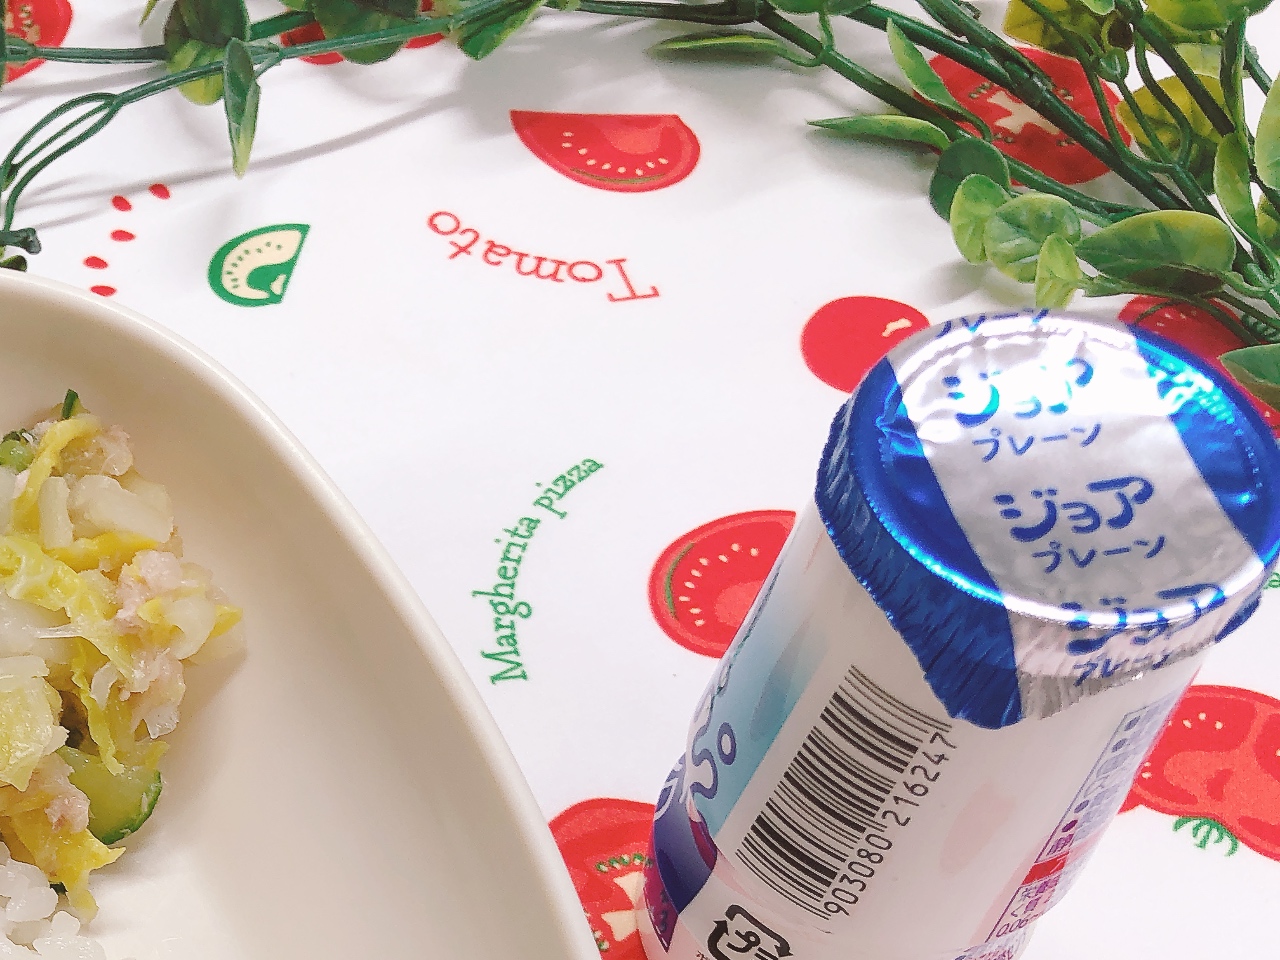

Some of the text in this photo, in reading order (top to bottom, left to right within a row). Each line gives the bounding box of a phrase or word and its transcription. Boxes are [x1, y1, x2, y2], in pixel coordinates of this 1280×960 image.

[427, 210, 660, 303] Tomato
[972, 422, 1102, 463] プレーン
[992, 476, 1155, 543] ジョア
[471, 457, 605, 684] Margherita pizza
[1031, 535, 1167, 574] プレーン
